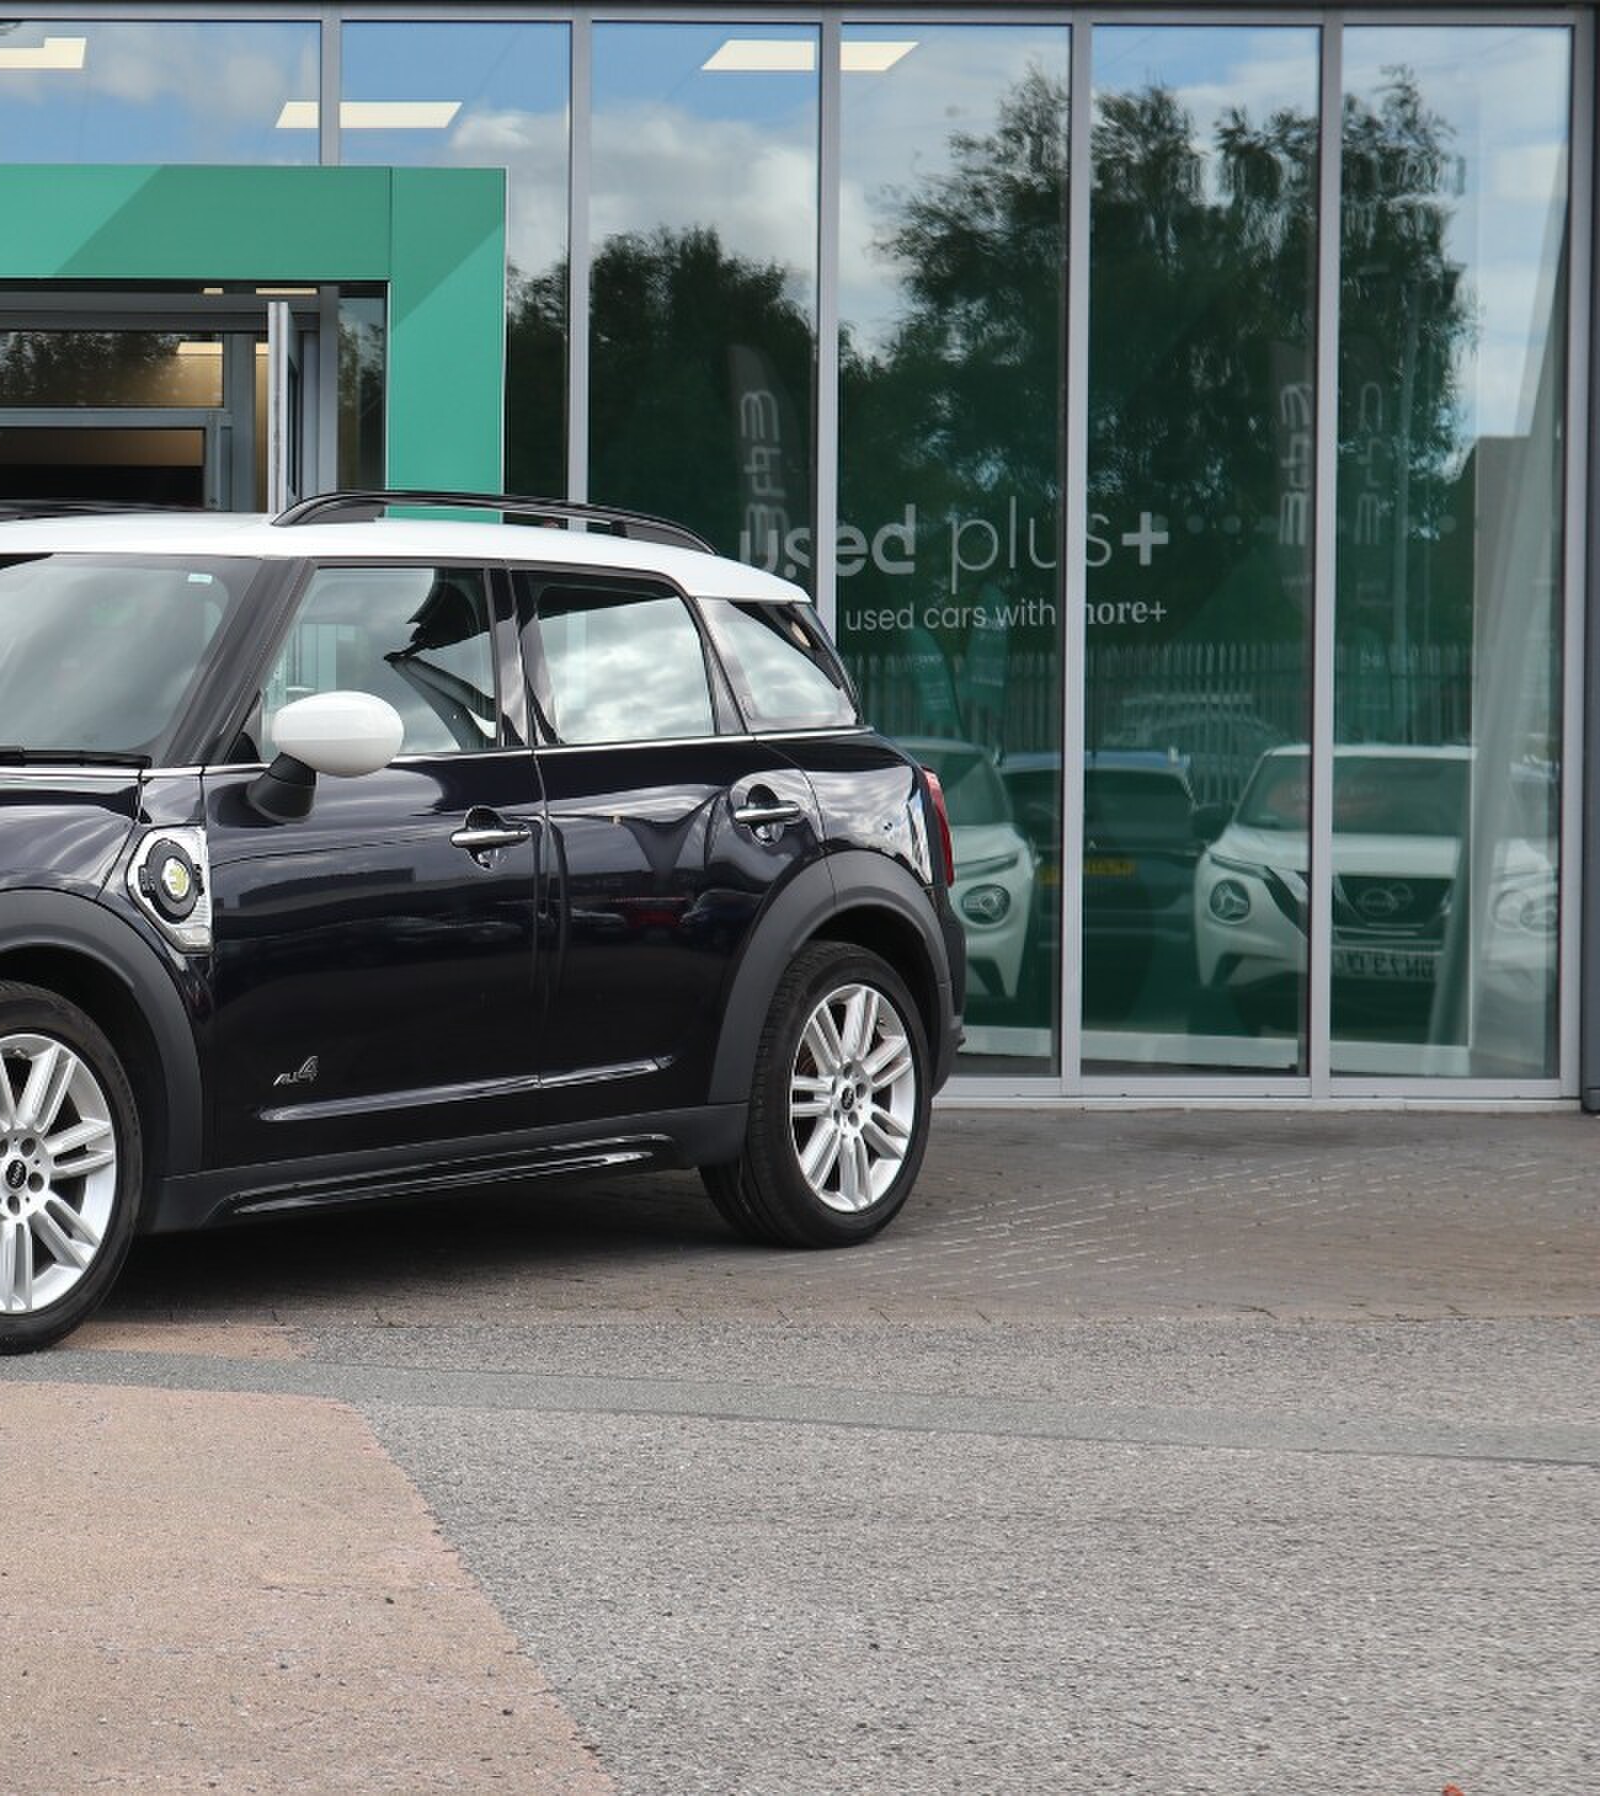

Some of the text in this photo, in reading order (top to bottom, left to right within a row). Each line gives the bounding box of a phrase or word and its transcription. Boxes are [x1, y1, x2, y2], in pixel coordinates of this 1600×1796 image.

[739, 503, 917, 578] used
[845, 602, 915, 632] used
[923, 606, 988, 631] cars
[995, 598, 1057, 630] with
